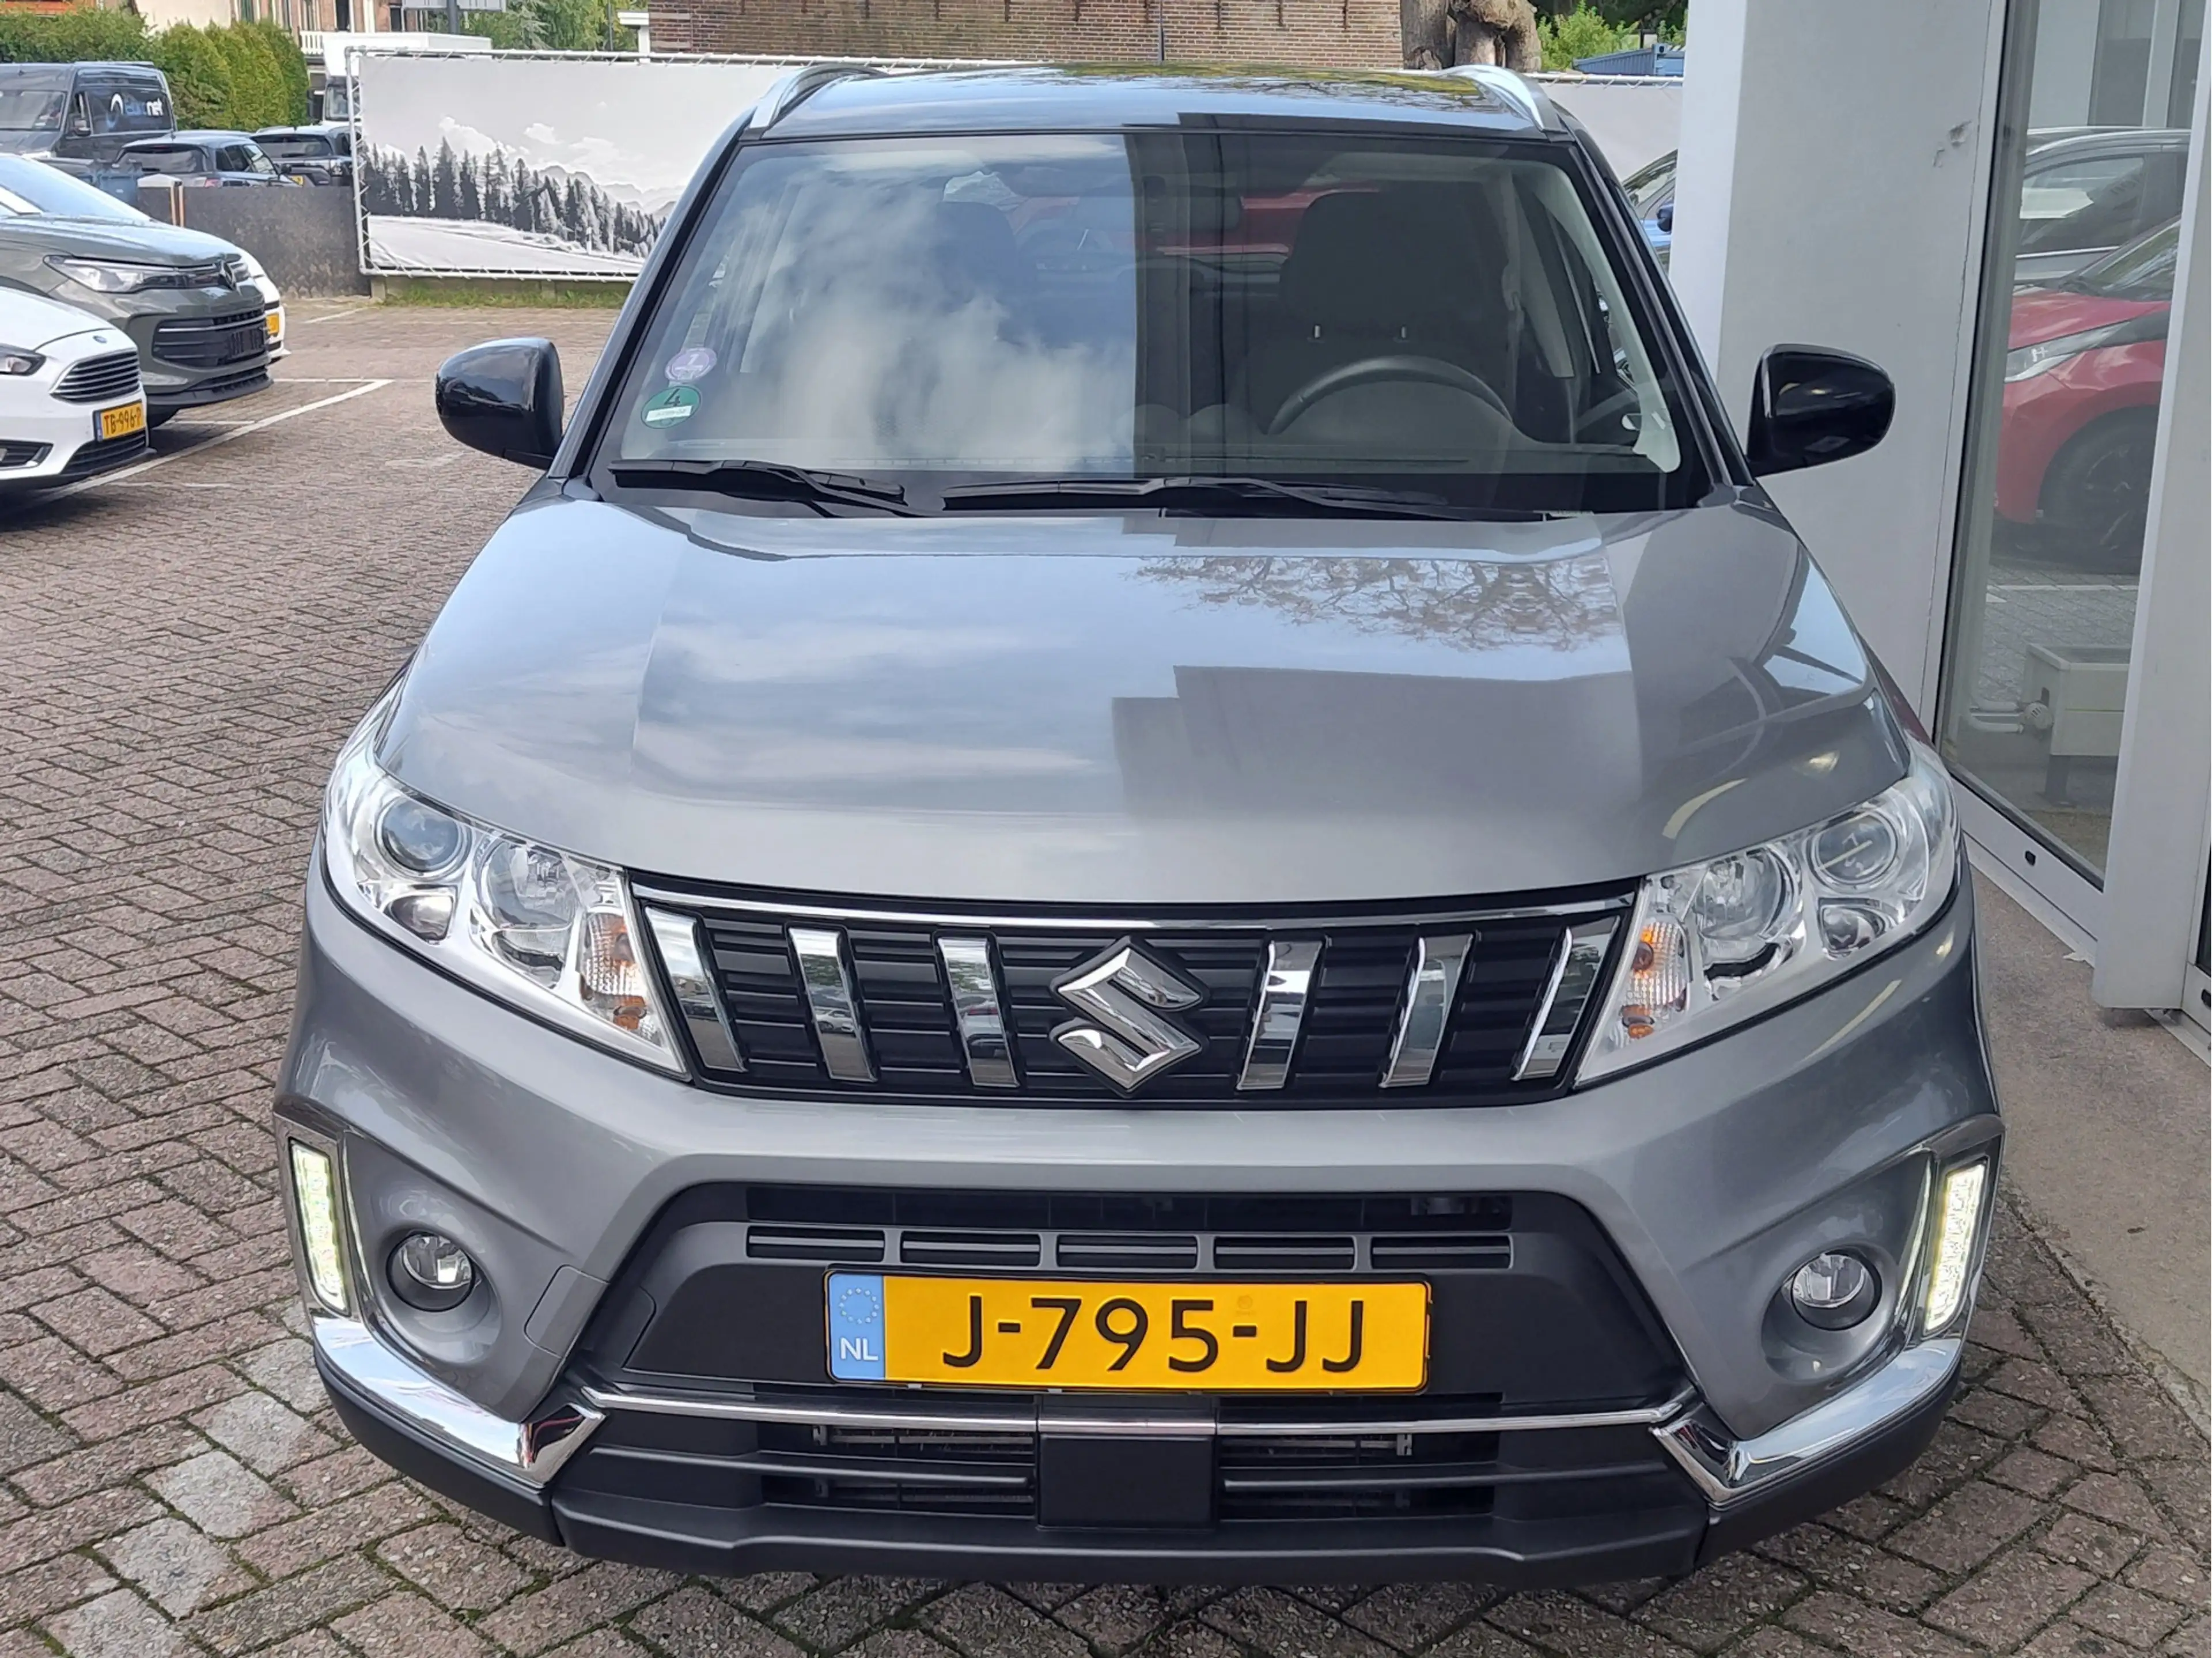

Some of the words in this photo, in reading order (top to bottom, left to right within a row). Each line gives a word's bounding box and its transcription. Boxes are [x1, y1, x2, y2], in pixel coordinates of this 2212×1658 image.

[664, 388, 680, 406] 4
[840, 1337, 879, 1361] NL
[942, 1295, 1365, 1373] J-795-JJ
